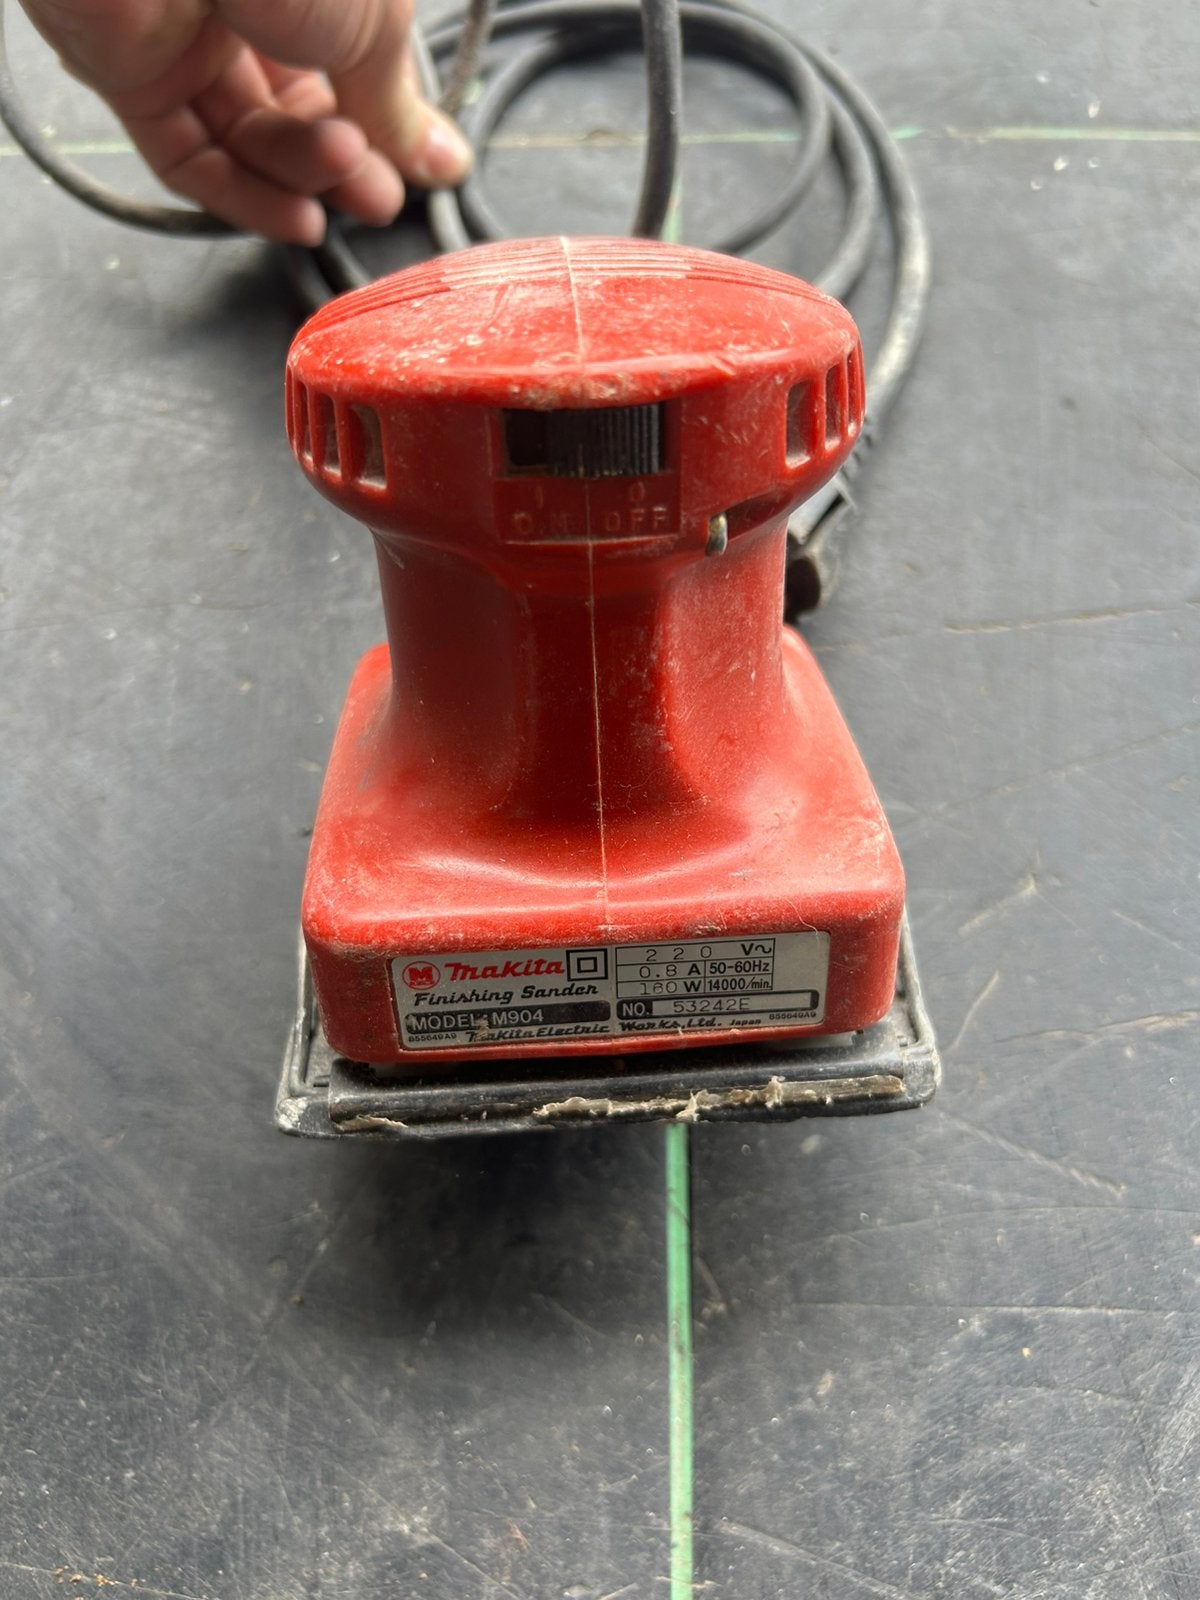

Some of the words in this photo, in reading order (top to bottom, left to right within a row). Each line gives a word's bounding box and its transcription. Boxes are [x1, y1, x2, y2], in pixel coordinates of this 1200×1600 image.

[605, 506, 668, 532] OFF
[444, 959, 565, 981] Makita
[639, 964, 678, 979] 0.8
[687, 963, 702, 976] A
[710, 960, 770, 975] 50-60Hz
[414, 989, 514, 1006] Finishing
[521, 983, 599, 999] Sander
[683, 980, 702, 993] W
[673, 998, 751, 1013] 53242E
[492, 1009, 544, 1026] M904
[536, 1024, 610, 1038] Electric
